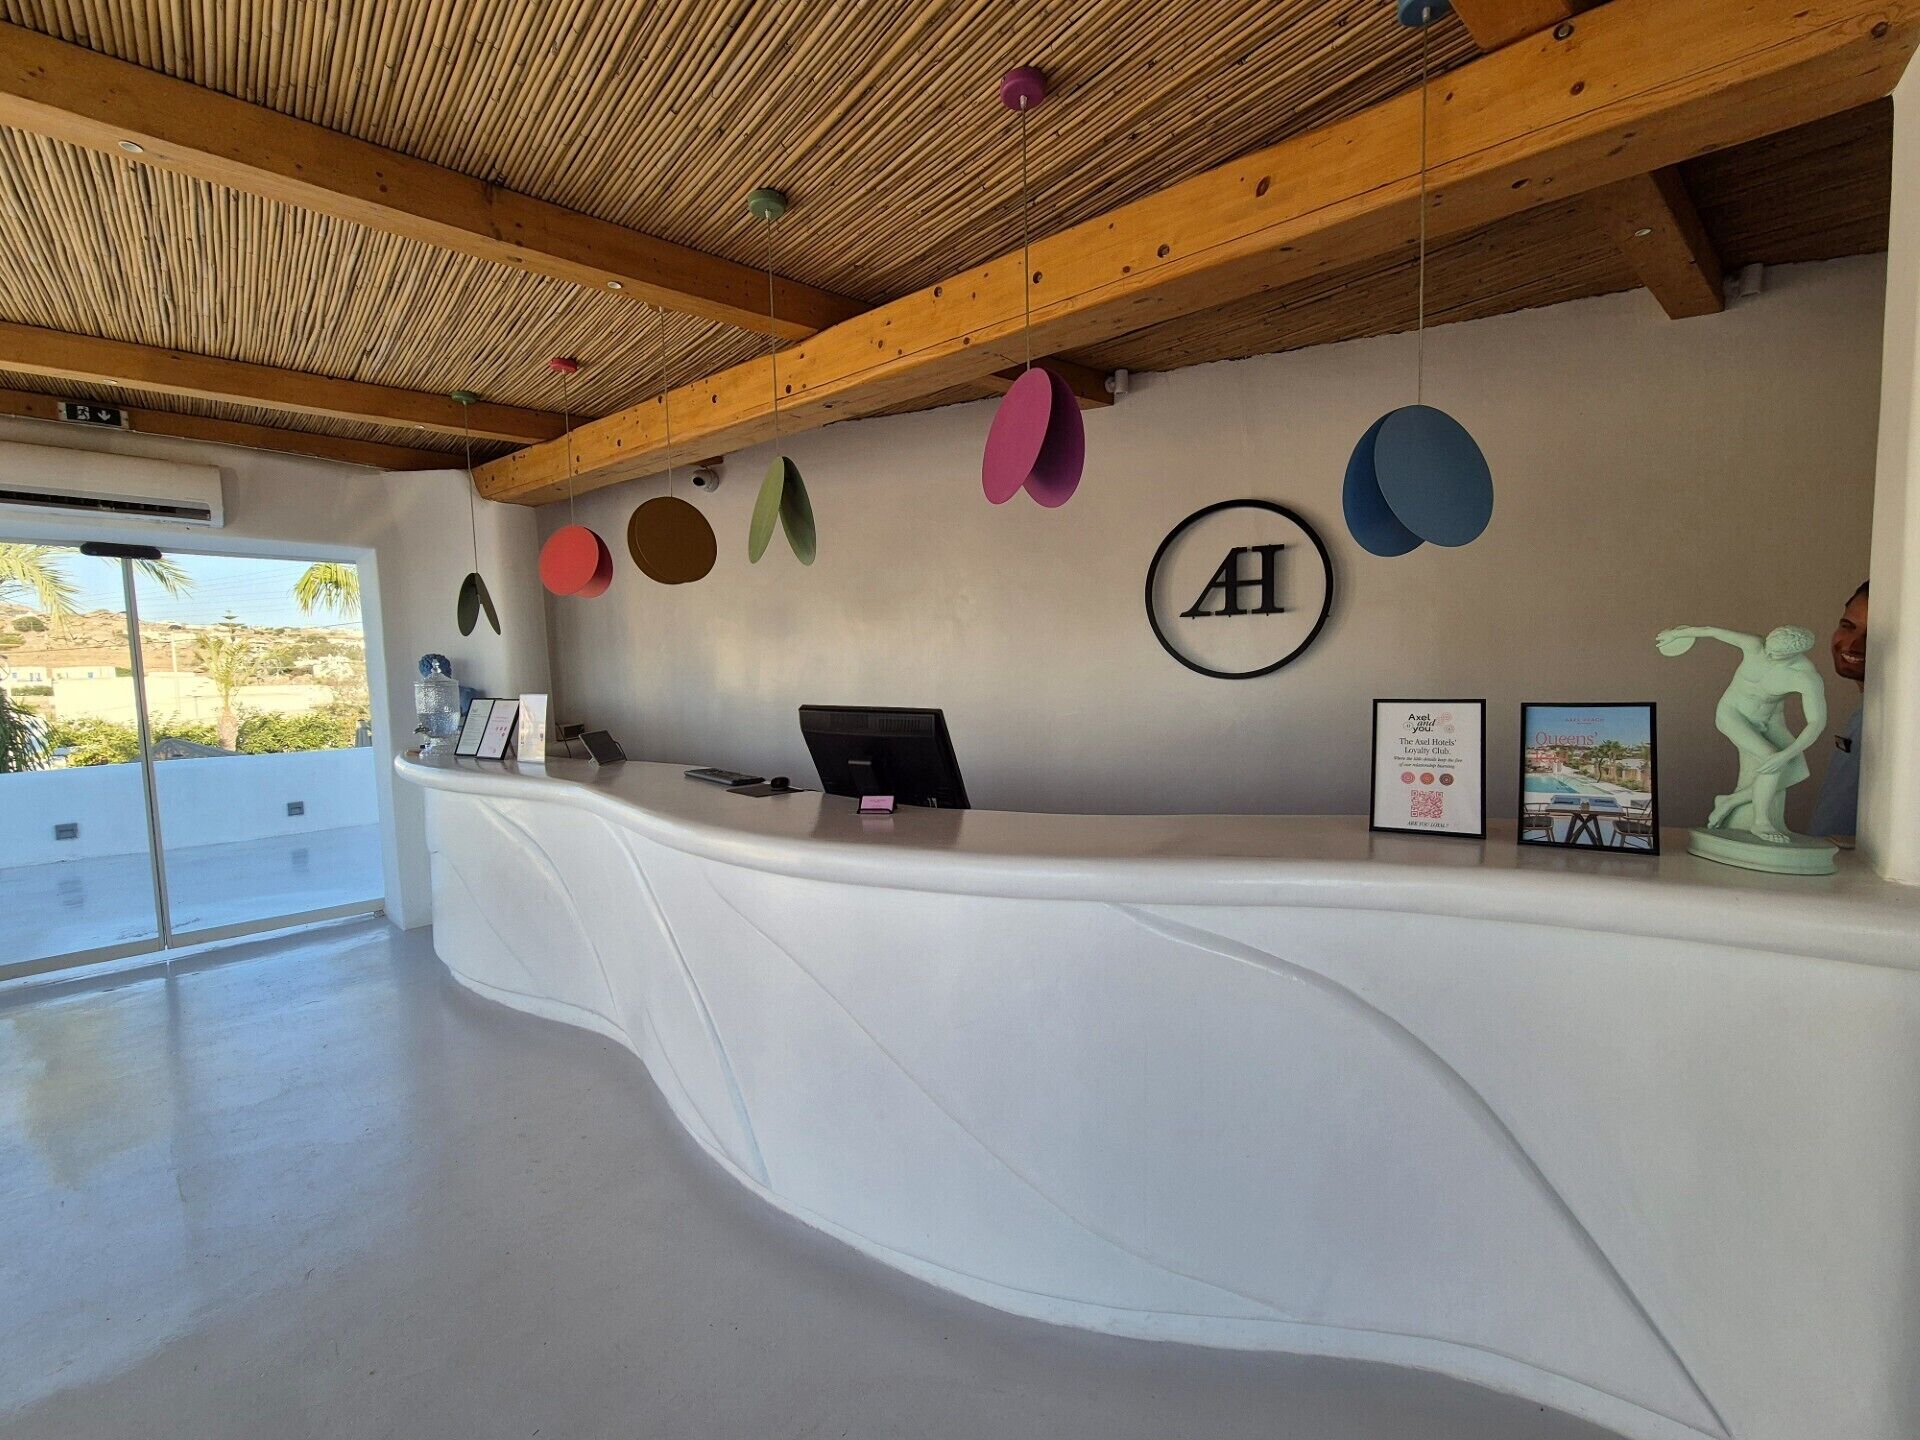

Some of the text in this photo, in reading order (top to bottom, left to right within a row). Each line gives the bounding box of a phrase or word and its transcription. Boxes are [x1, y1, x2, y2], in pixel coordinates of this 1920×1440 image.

[1417, 719, 1436, 727] and
[1412, 726, 1434, 734] you.
[1399, 738, 1413, 746] The
[1415, 738, 1430, 746] Axel
[1404, 747, 1430, 755] Loyalty
